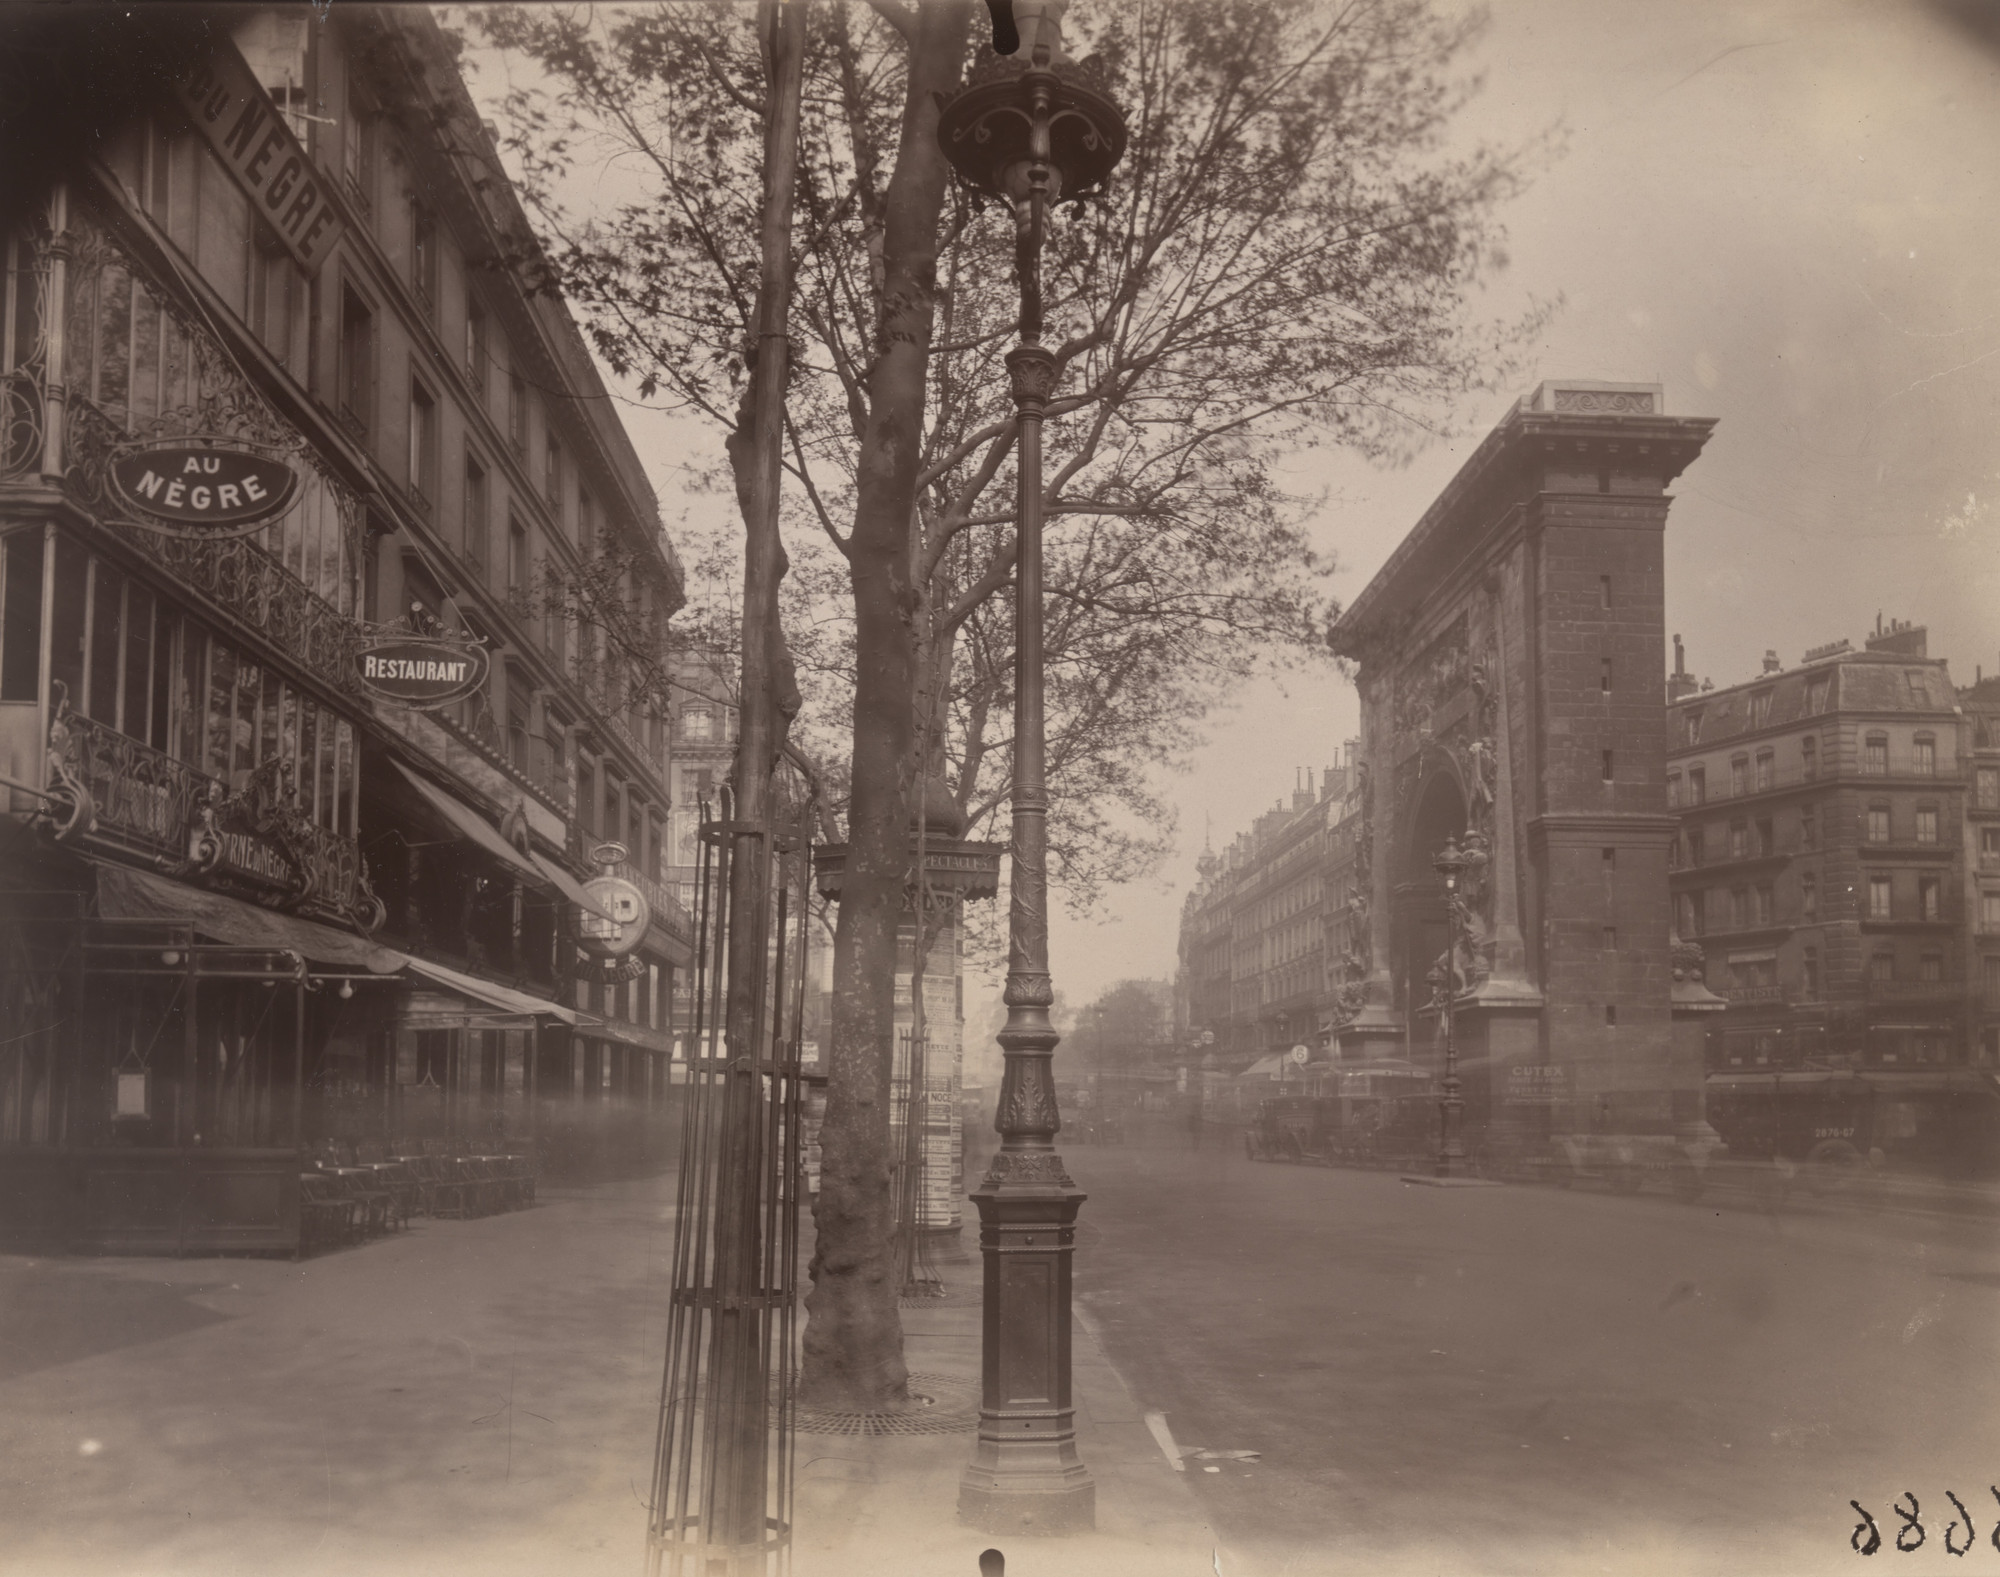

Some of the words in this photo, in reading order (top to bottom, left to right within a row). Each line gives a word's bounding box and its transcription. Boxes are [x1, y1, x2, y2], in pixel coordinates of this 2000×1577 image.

[183, 456, 221, 474] AU
[135, 469, 268, 510] NÈGRE
[364, 655, 467, 682] RESTAURANT
[1511, 1065, 1565, 1077] CUTEX
